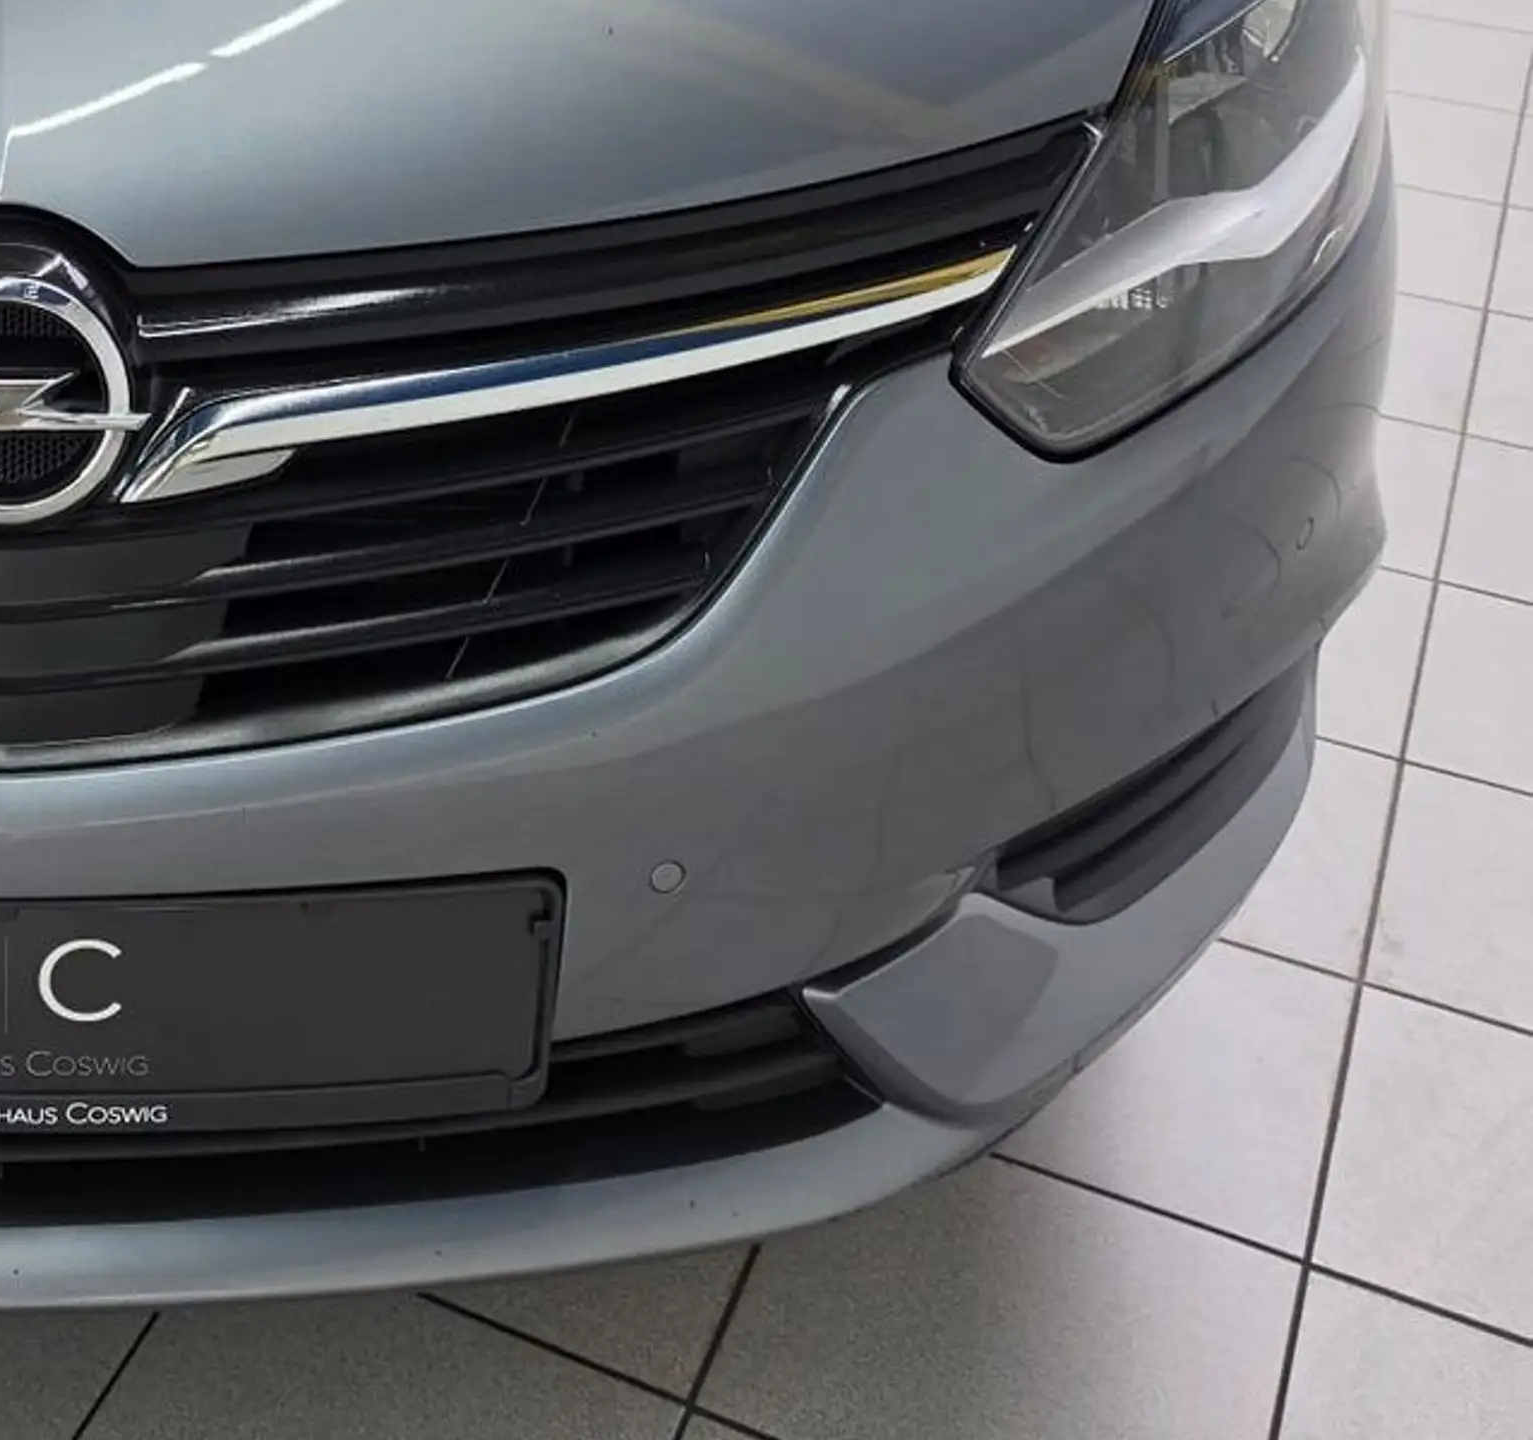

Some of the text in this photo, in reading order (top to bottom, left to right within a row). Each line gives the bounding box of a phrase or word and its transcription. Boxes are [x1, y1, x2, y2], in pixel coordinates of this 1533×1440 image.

[38, 938, 122, 1022] C
[25, 1050, 150, 1077] COSWIG
[65, 1101, 168, 1125] COSWIG
